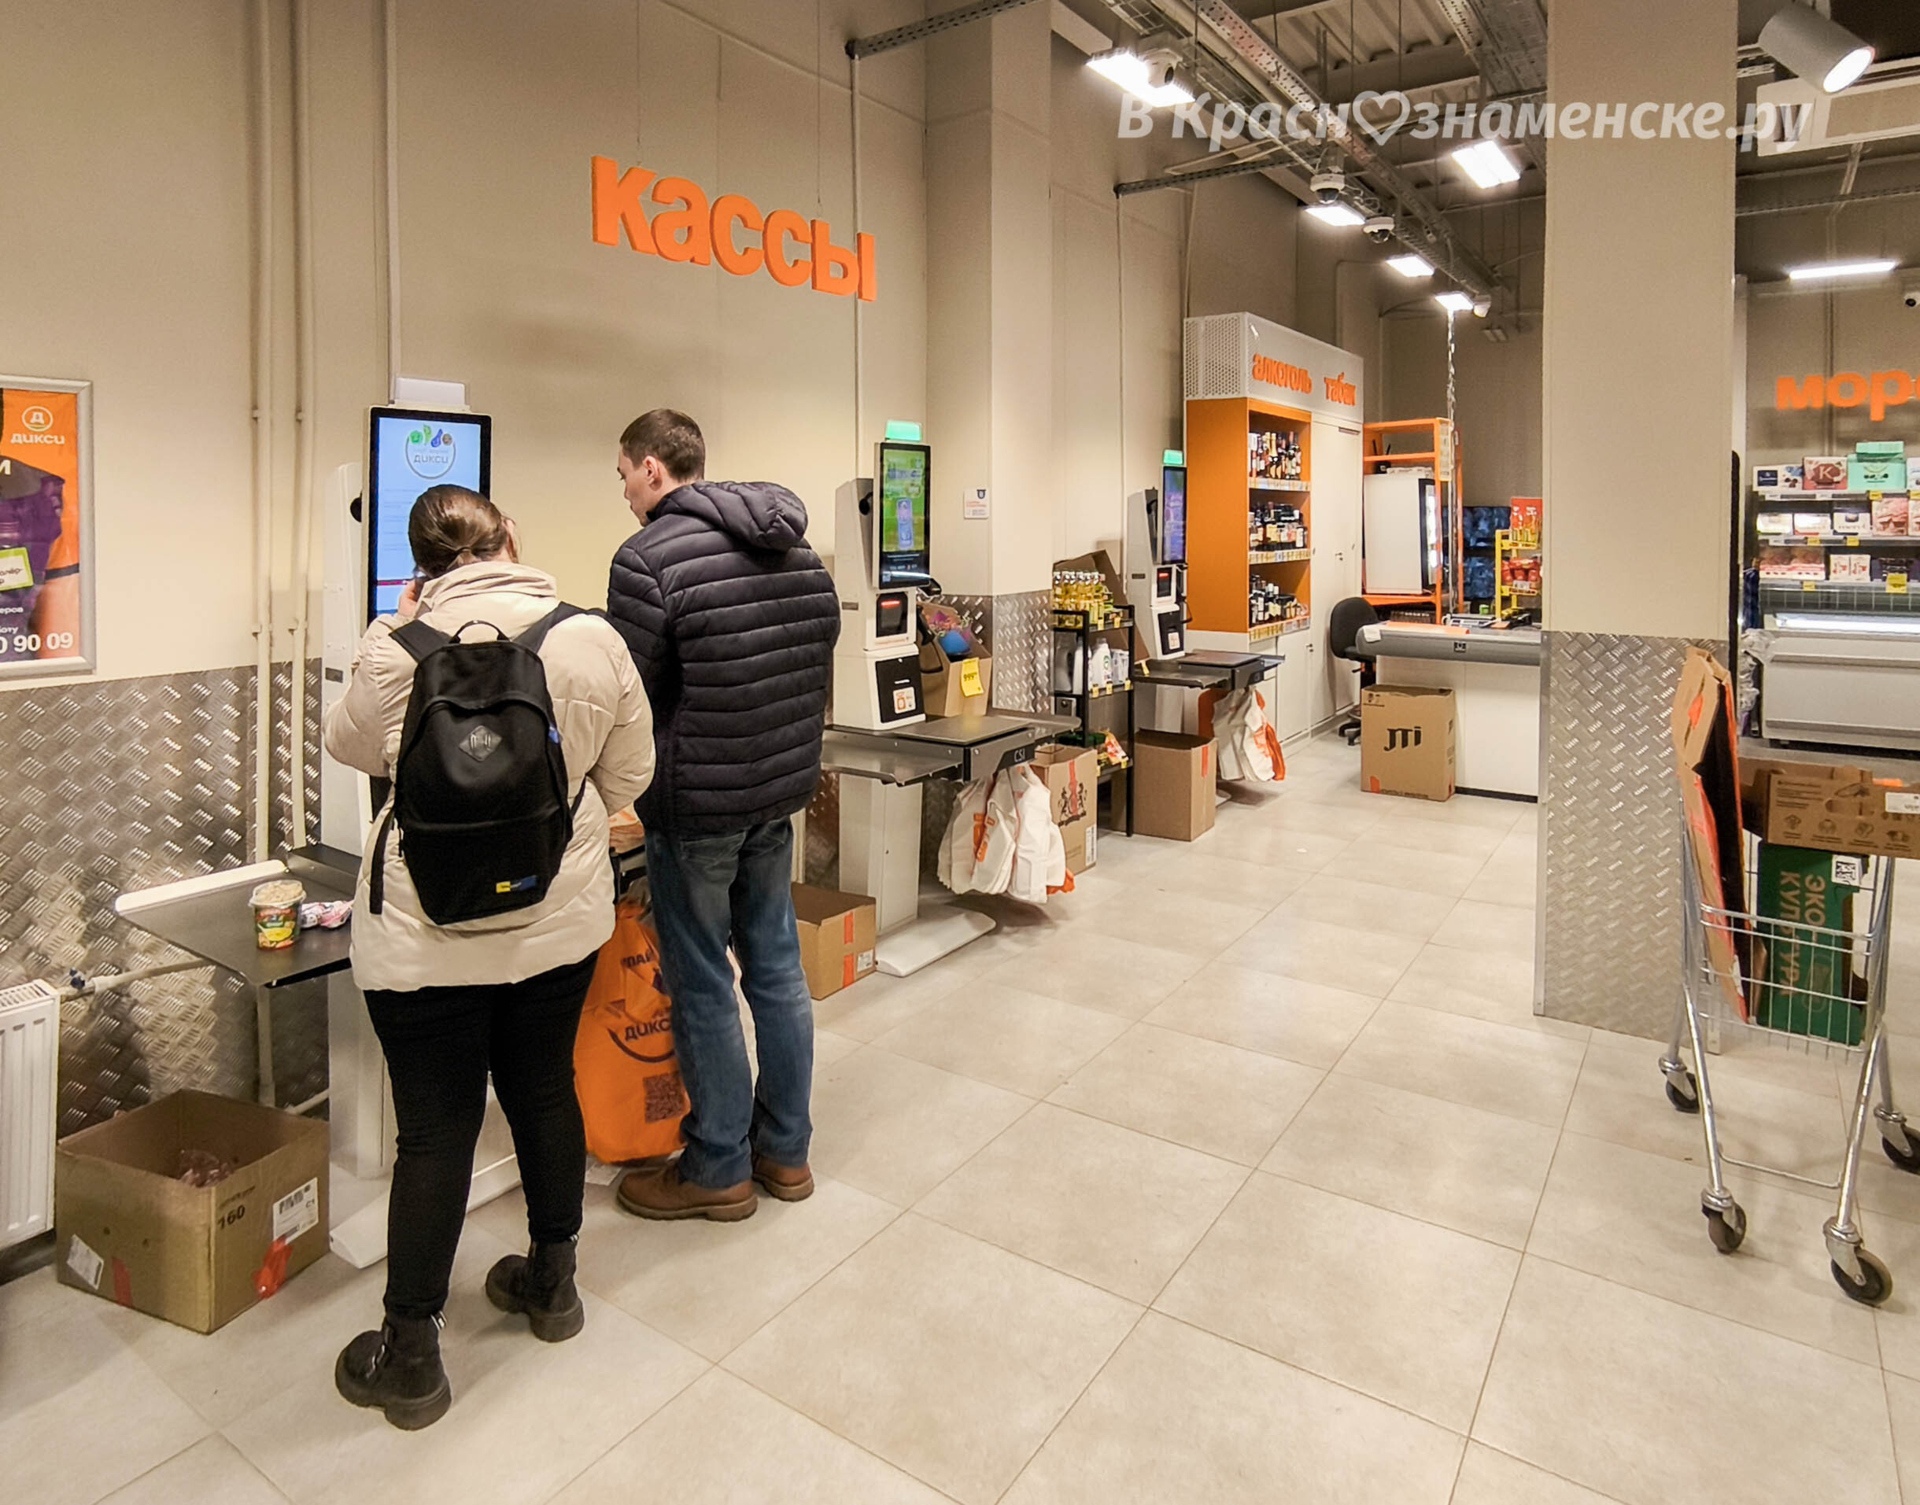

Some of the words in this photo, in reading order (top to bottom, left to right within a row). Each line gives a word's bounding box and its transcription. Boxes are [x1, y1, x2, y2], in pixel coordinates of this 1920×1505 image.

[591, 155, 877, 302] кассы
[1252, 353, 1312, 395] алкоголь
[1323, 371, 1356, 406] табак
[1776, 370, 1920, 421] мор
[13, 634, 41, 652] 90
[46, 632, 74, 650] 09
